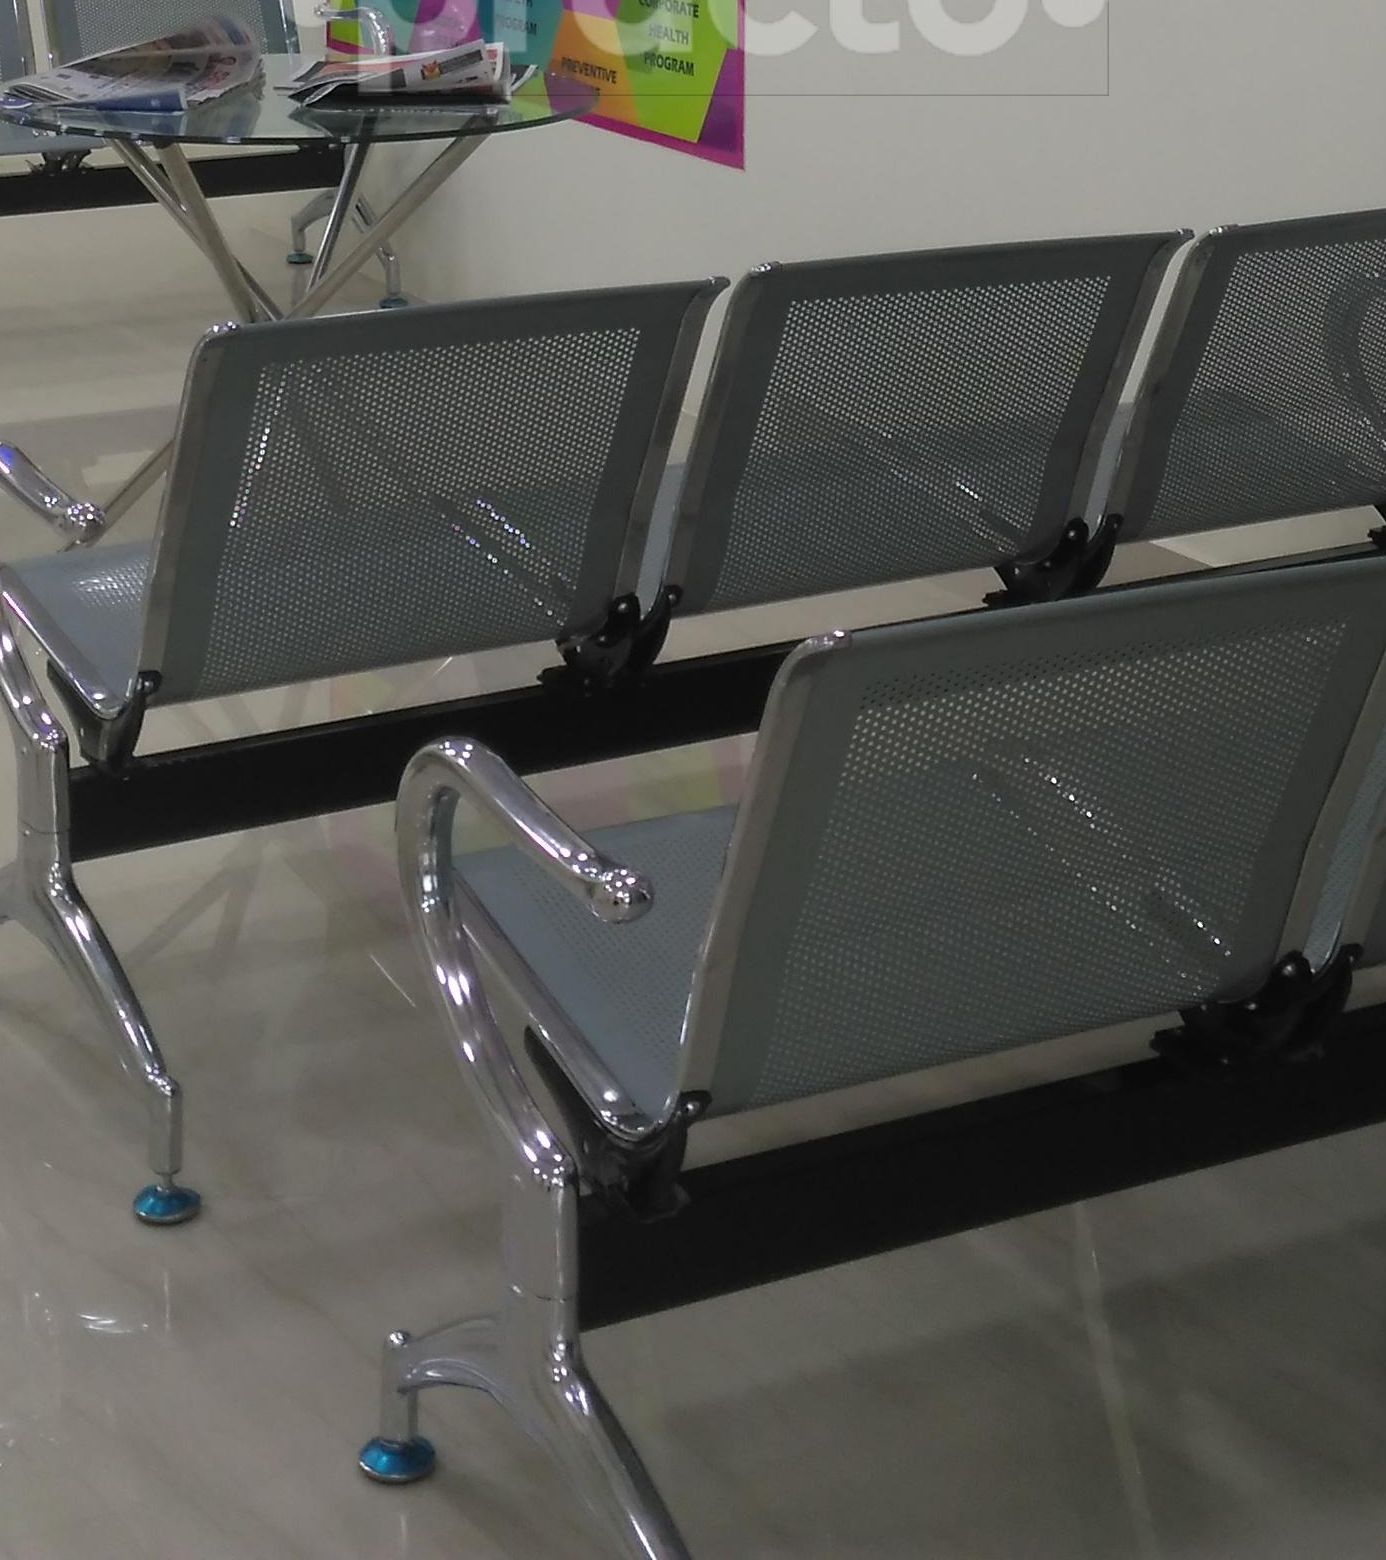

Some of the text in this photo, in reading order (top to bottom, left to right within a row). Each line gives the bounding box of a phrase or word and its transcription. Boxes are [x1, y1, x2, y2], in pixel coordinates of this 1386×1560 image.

[495, 15, 537, 36] PROGRAM
[648, 23, 689, 45] HEALTH
[561, 56, 617, 85] PREVENTIVE
[644, 52, 695, 76] PROGRAM
